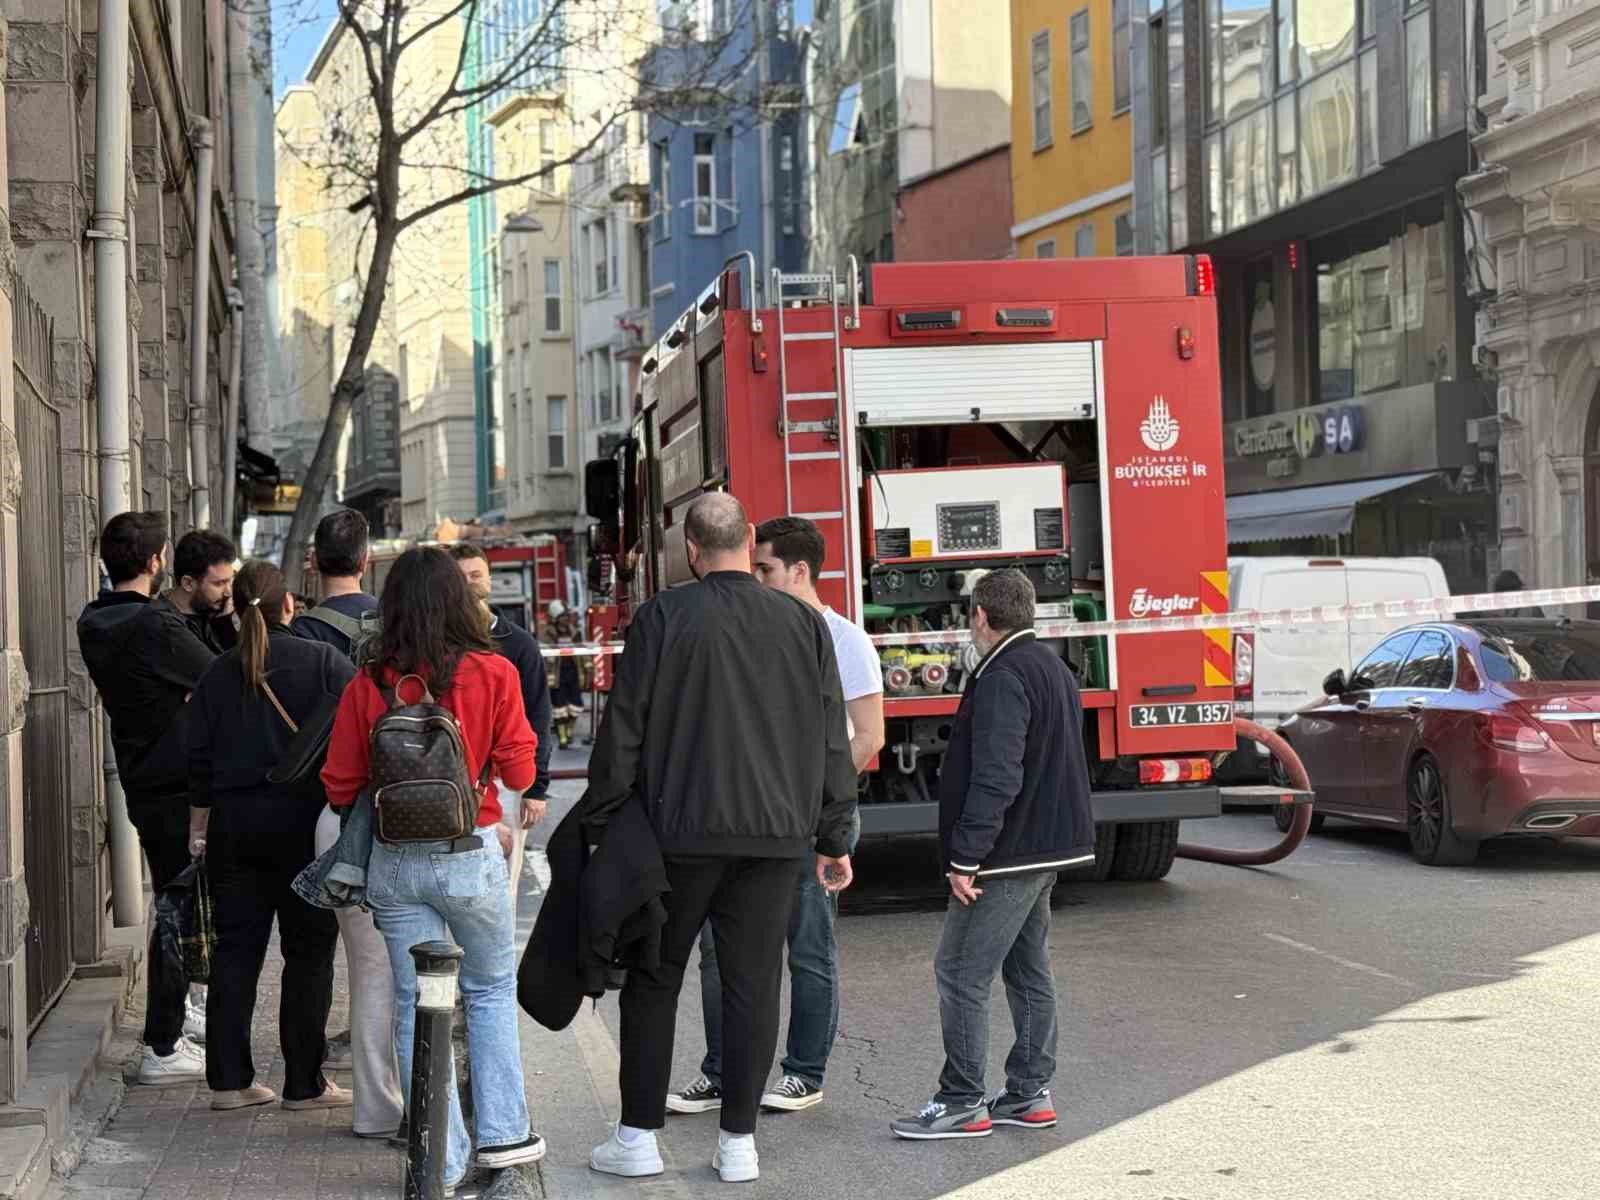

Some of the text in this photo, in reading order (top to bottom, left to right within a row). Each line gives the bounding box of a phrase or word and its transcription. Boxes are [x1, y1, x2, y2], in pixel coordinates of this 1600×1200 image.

[1325, 415, 1353, 445] SA
[1139, 704, 1230, 726] 34 VZ 1357
